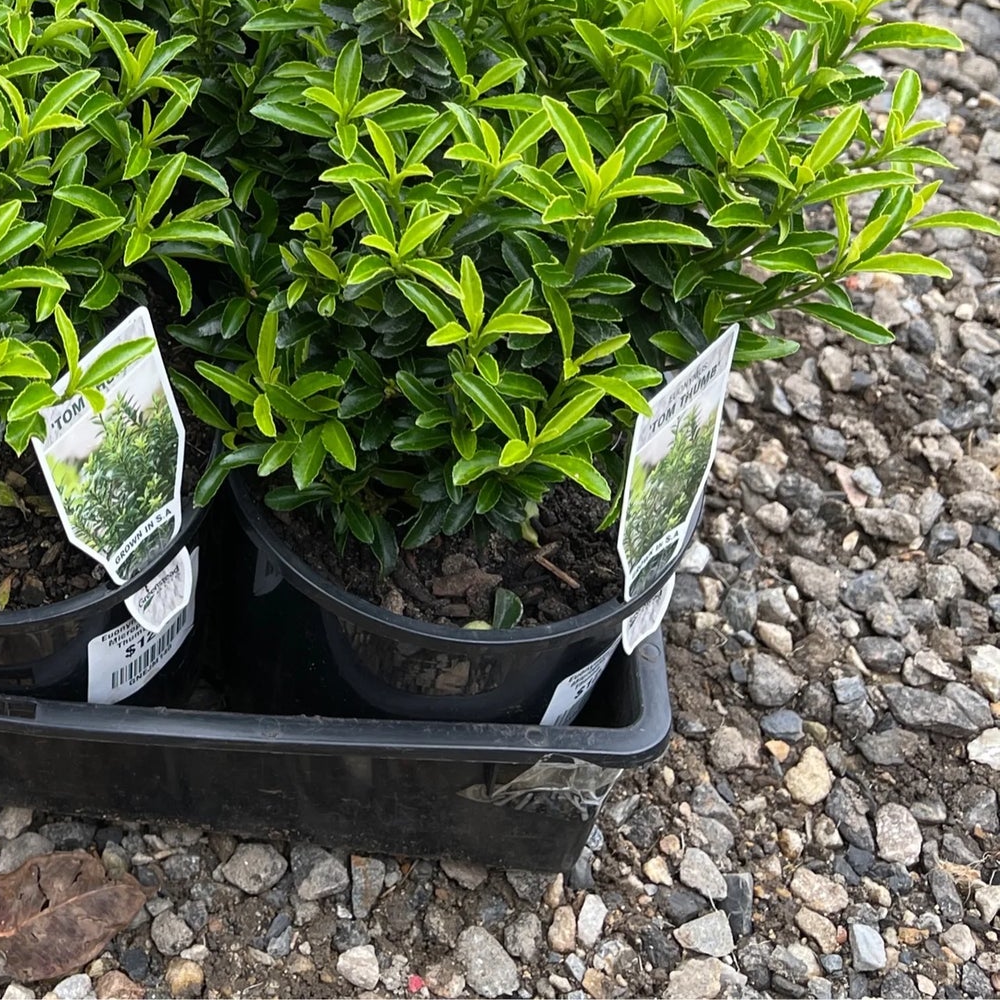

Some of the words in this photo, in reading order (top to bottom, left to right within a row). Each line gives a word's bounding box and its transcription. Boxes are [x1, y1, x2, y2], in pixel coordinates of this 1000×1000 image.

[51, 397, 86, 430] 'TOM
[115, 530, 143, 565] GROWN
[144, 520, 154, 533] IN
